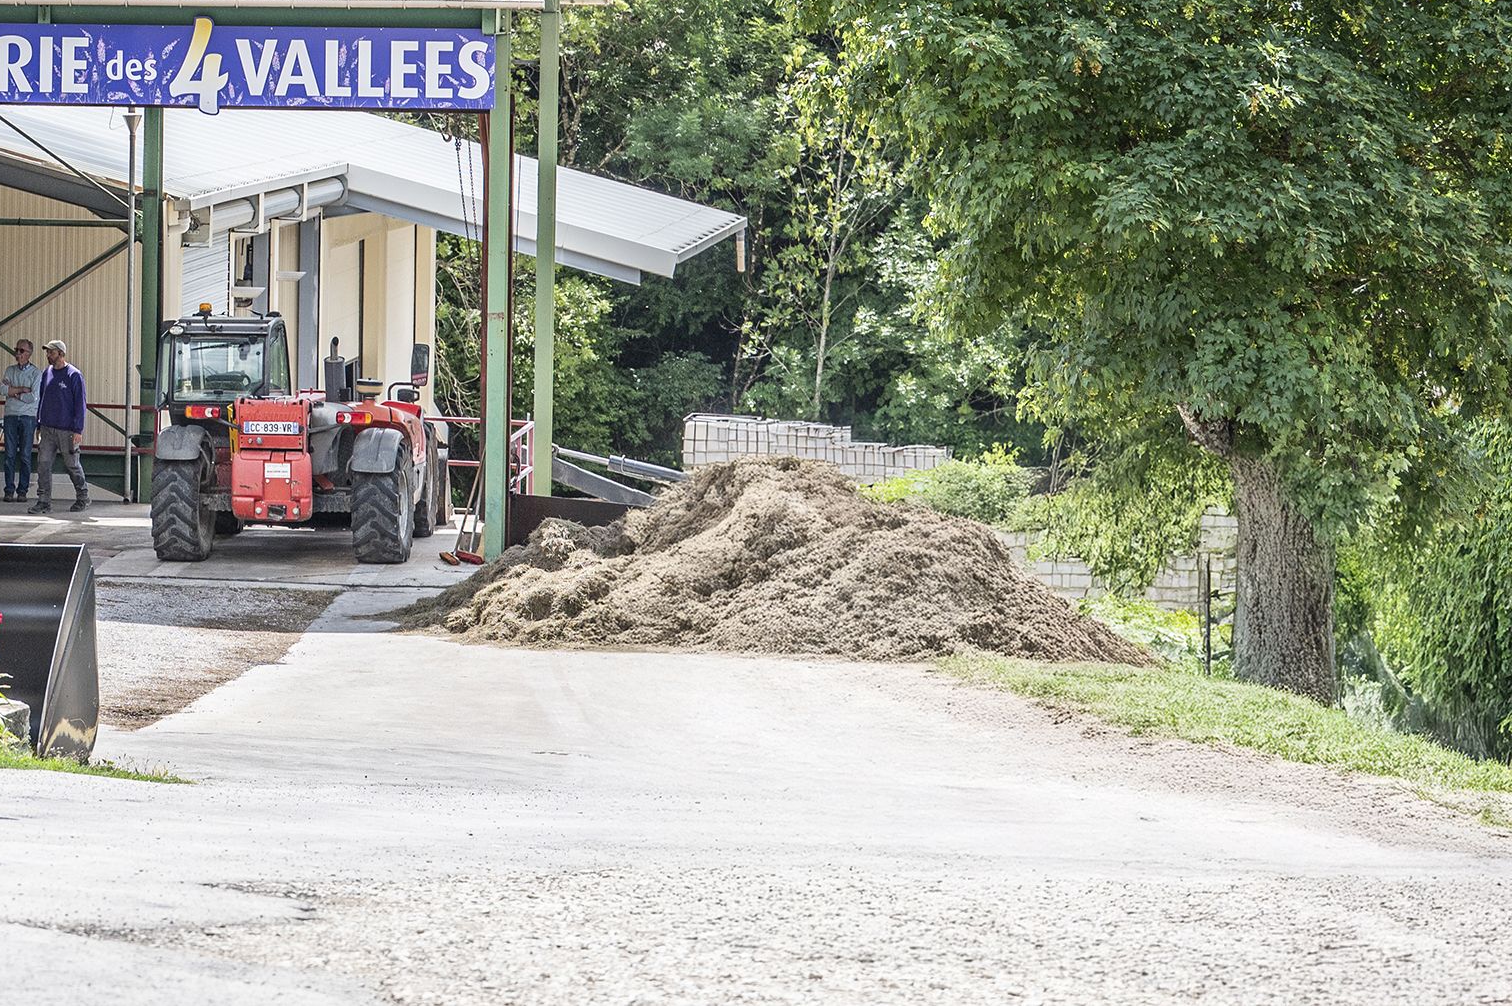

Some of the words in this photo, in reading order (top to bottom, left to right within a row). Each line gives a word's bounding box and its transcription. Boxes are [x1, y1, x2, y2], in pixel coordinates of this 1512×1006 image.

[106, 49, 158, 82] des
[168, 16, 230, 115] 4
[235, 38, 491, 100] VALLEES
[250, 423, 293, 433] CC-839-VR
